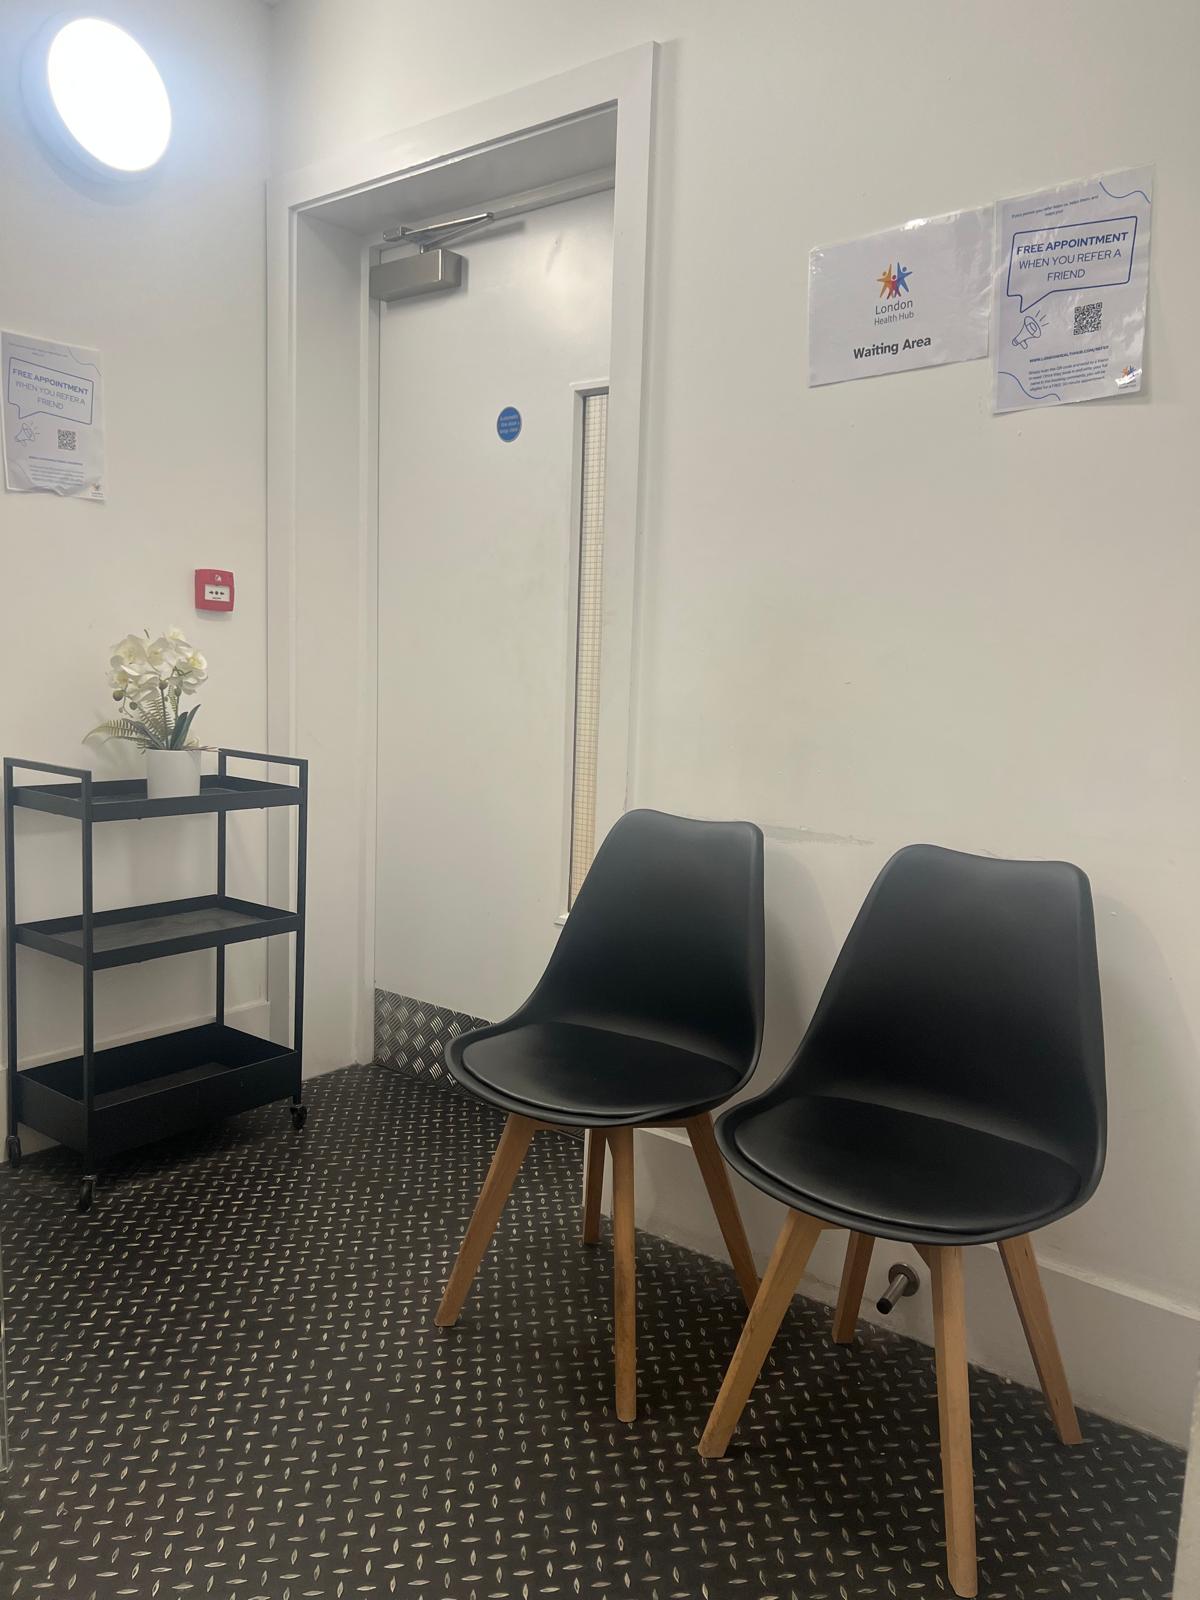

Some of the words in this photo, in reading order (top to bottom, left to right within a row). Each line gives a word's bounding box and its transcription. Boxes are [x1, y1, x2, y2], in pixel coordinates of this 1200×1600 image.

[1016, 243, 1043, 256] FREE
[1045, 231, 1129, 251] APPOINTMENT
[1018, 257, 1049, 270] WHEN
[1052, 254, 1075, 266] YOU
[1077, 250, 1111, 262] REFER
[1112, 248, 1122, 258] A
[1047, 268, 1086, 281] FRIEND
[875, 299, 913, 315] London
[874, 313, 898, 326] Health
[898, 311, 914, 322] Hub
[853, 342, 899, 360] Waiting
[902, 336, 931, 350] Area
[12, 368, 33, 381] FREE
[34, 375, 89, 396] APPOINTMENT
[15, 381, 38, 392] WHEN
[38, 387, 55, 397] YOU
[56, 391, 79, 404] REFER
[78, 397, 86, 406] A
[37, 397, 64, 410] FRIEND
